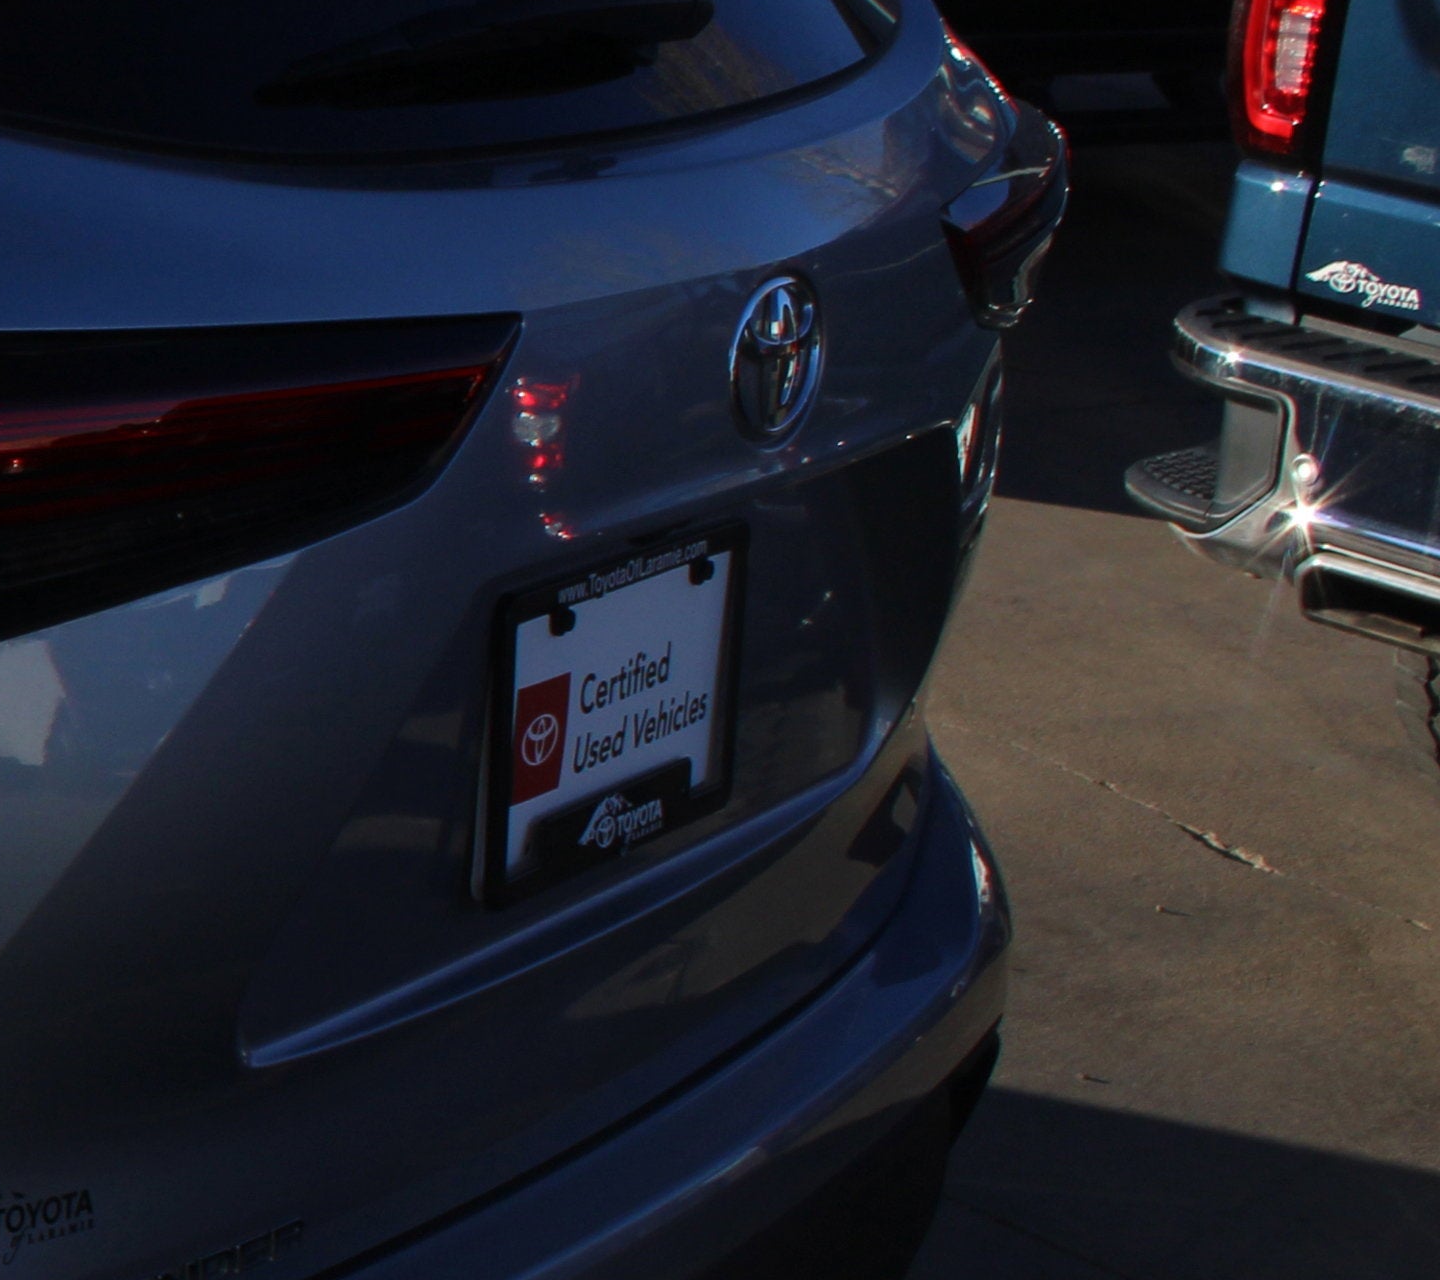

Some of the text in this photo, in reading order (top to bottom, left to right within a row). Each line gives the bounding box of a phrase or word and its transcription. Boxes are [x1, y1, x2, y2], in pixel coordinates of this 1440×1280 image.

[1357, 279, 1420, 304] TOYOTA
[557, 538, 709, 604] www.ToyotaOfLaramie.com
[579, 640, 673, 715] Certified
[572, 690, 708, 774] Used Vehicles
[616, 798, 664, 838] TOYOTA
[27, 1217, 97, 1247] LARAMIE
